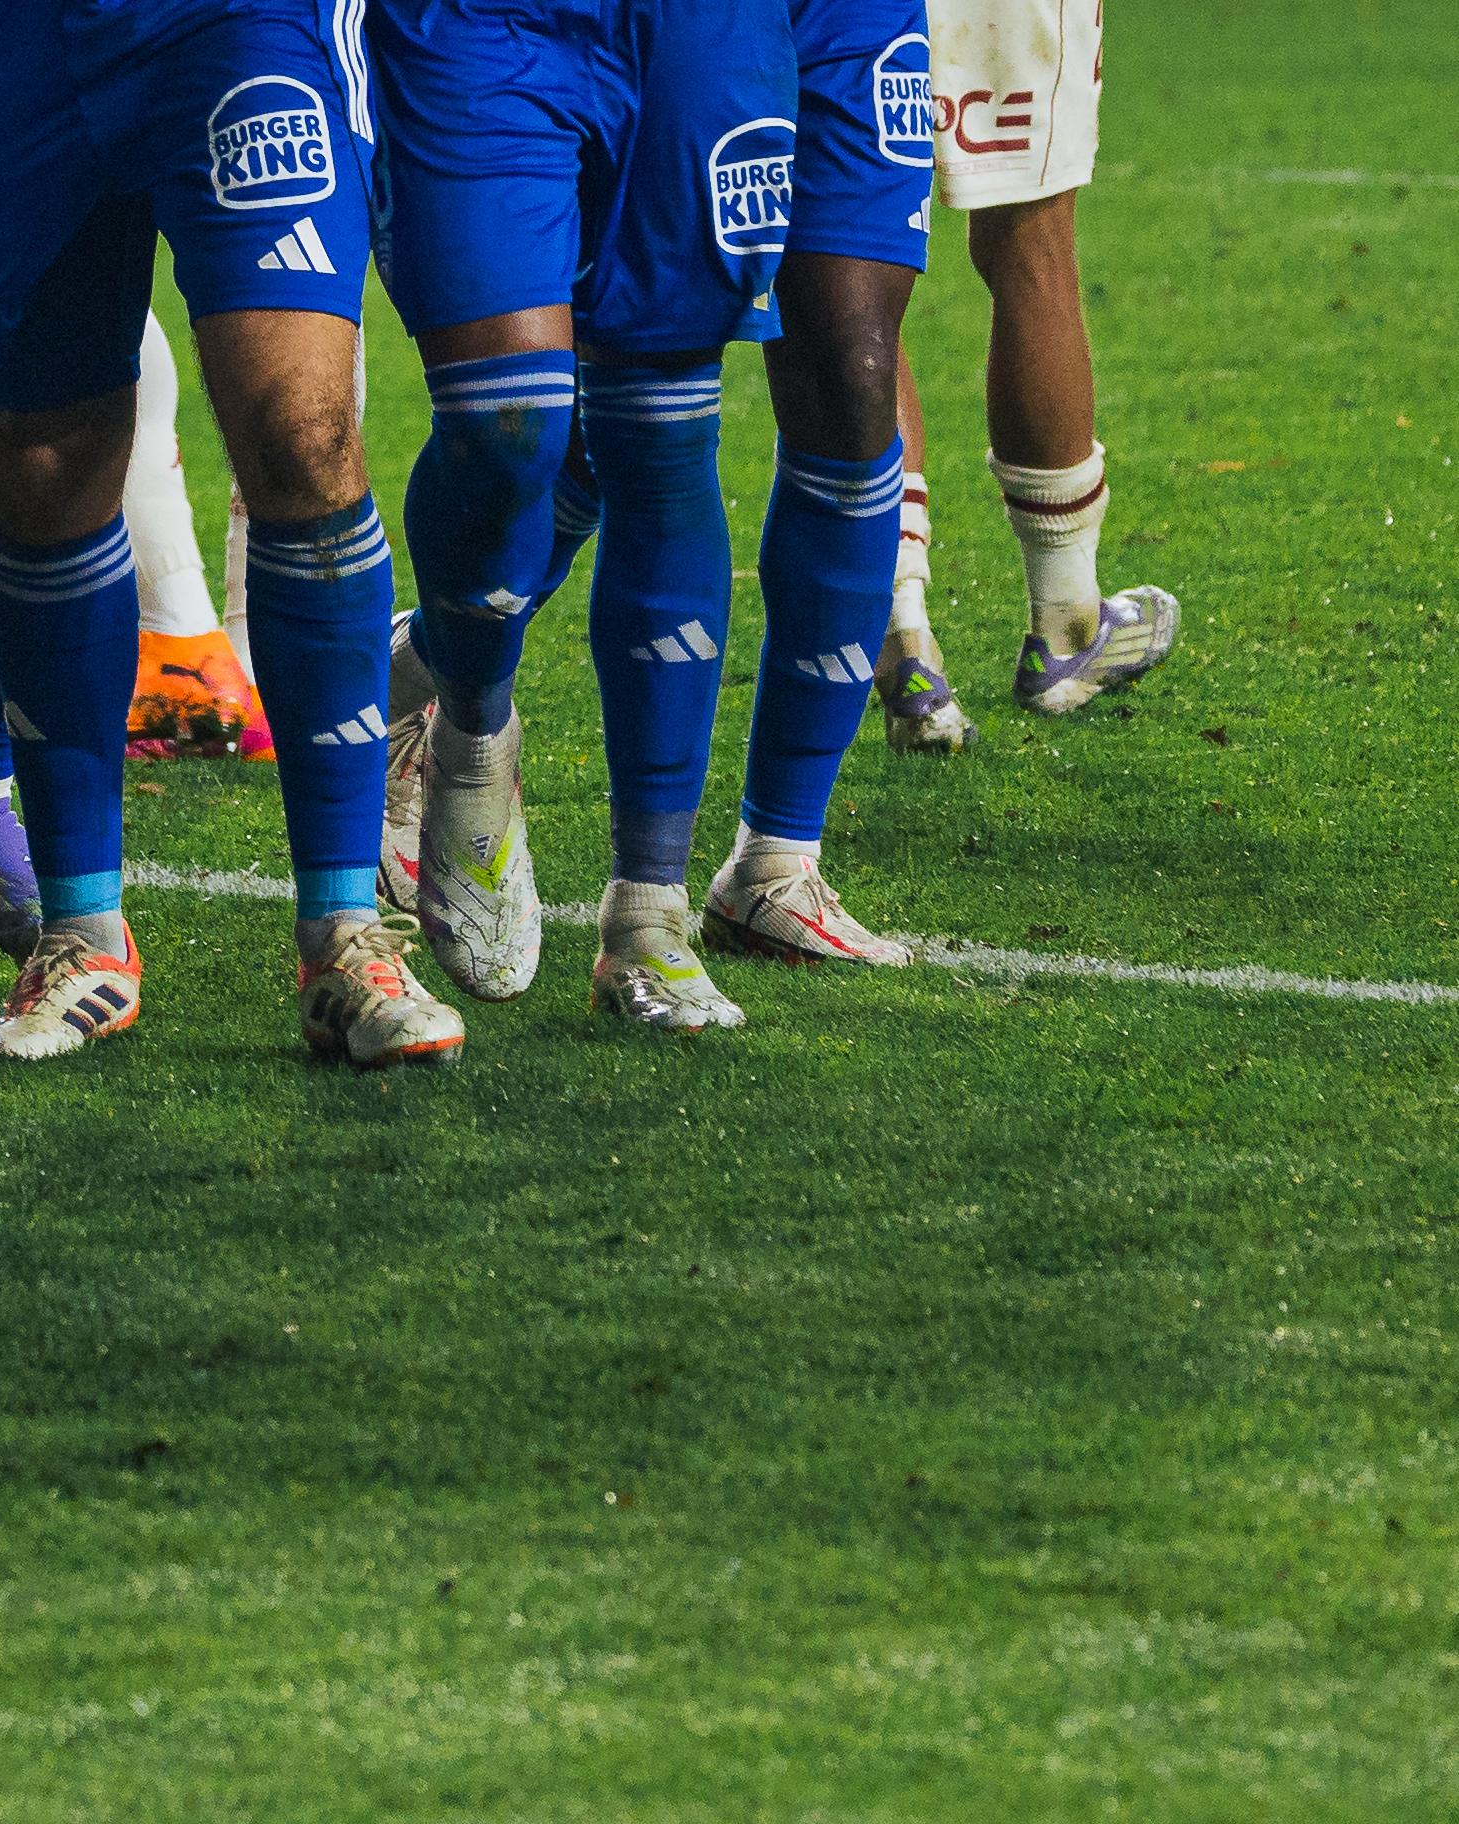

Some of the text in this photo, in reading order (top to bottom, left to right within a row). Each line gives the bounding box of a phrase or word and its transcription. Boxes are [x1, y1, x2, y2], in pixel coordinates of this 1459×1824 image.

[215, 114, 323, 156] BURGER
[882, 102, 933, 137] KIN
[217, 139, 327, 188] KING
[718, 188, 792, 230] KIN
